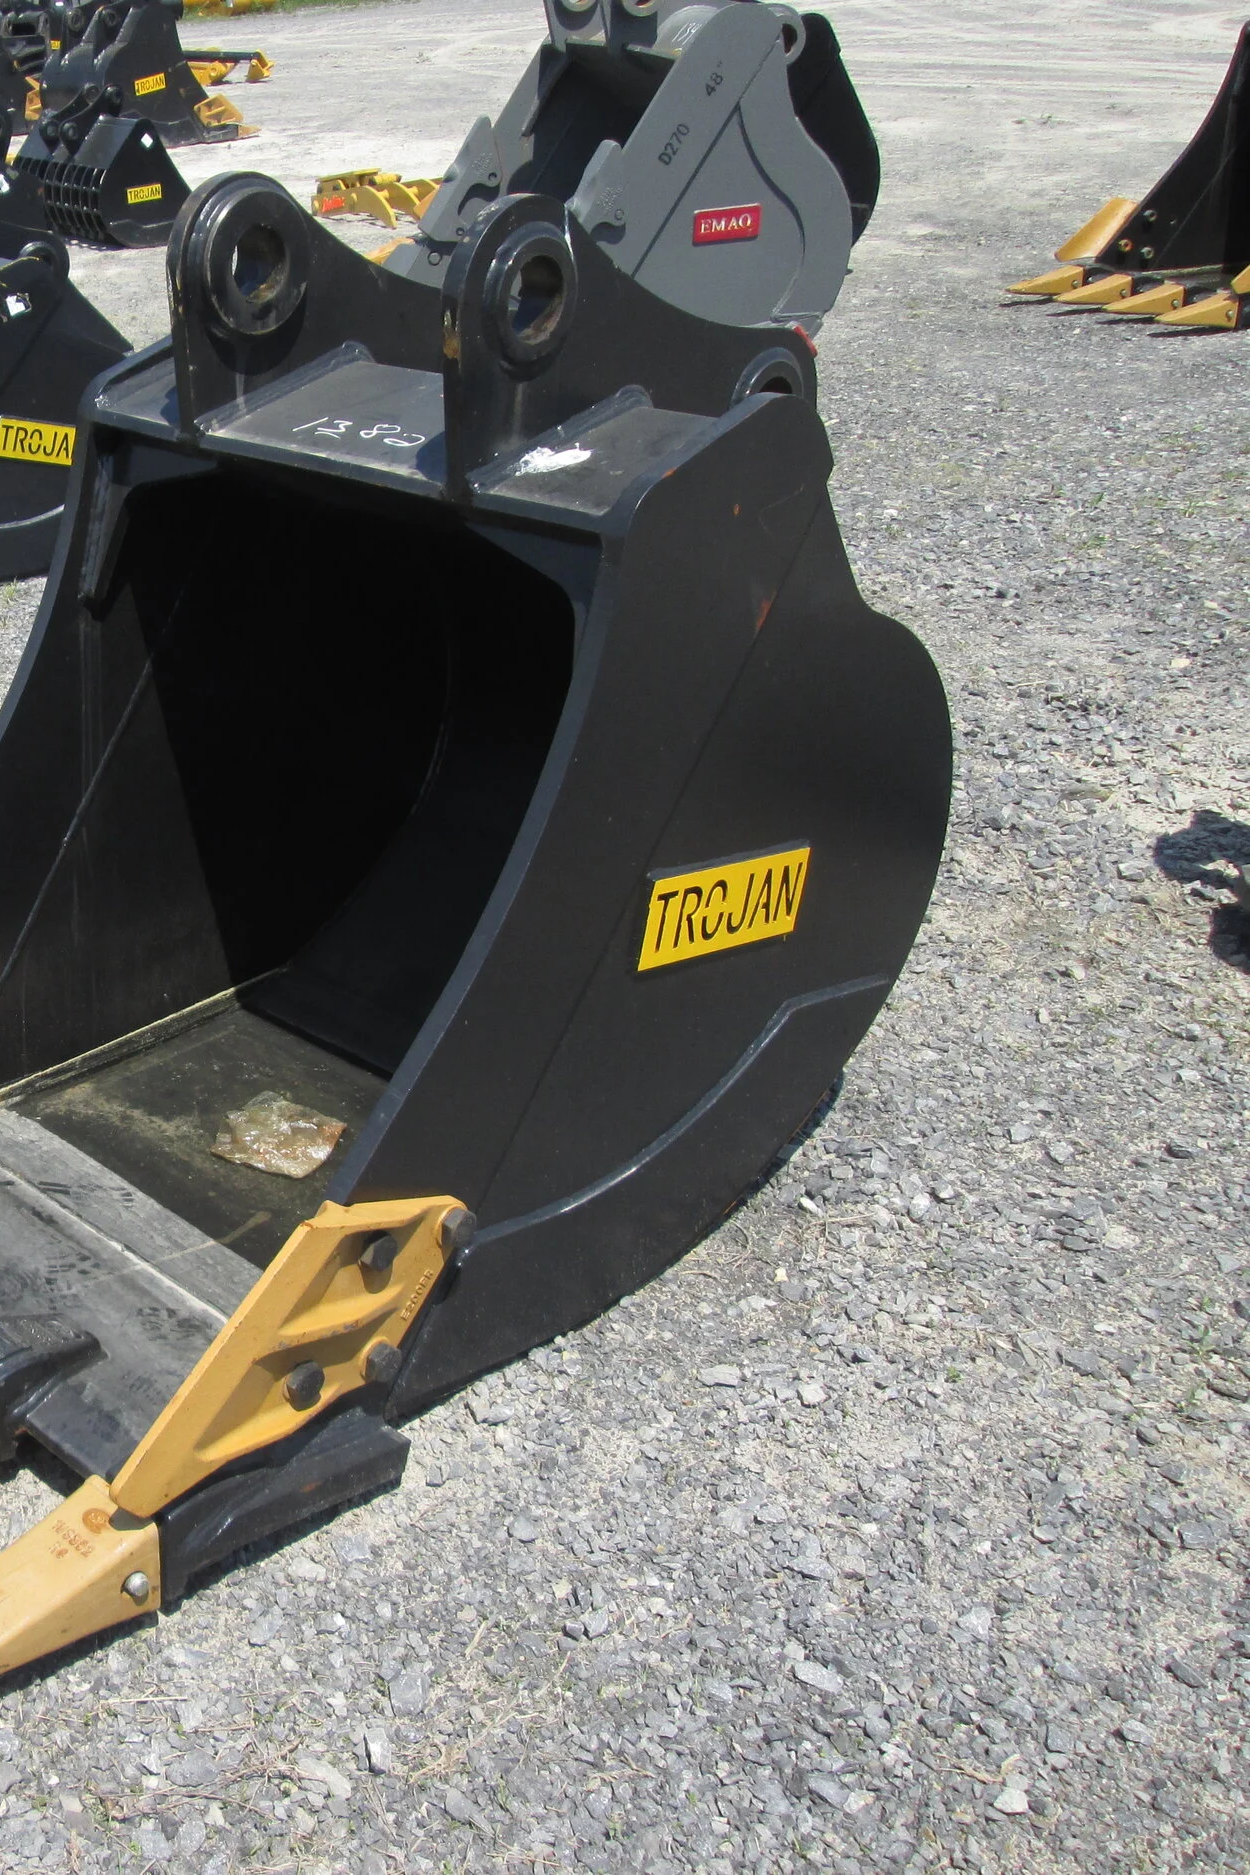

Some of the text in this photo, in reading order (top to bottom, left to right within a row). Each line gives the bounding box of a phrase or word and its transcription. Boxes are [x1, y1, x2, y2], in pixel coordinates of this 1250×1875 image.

[135, 75, 165, 94] TROJAN
[657, 123, 690, 166] D270
[128, 185, 160, 201] TROJAN
[654, 861, 803, 954] TROJAN
